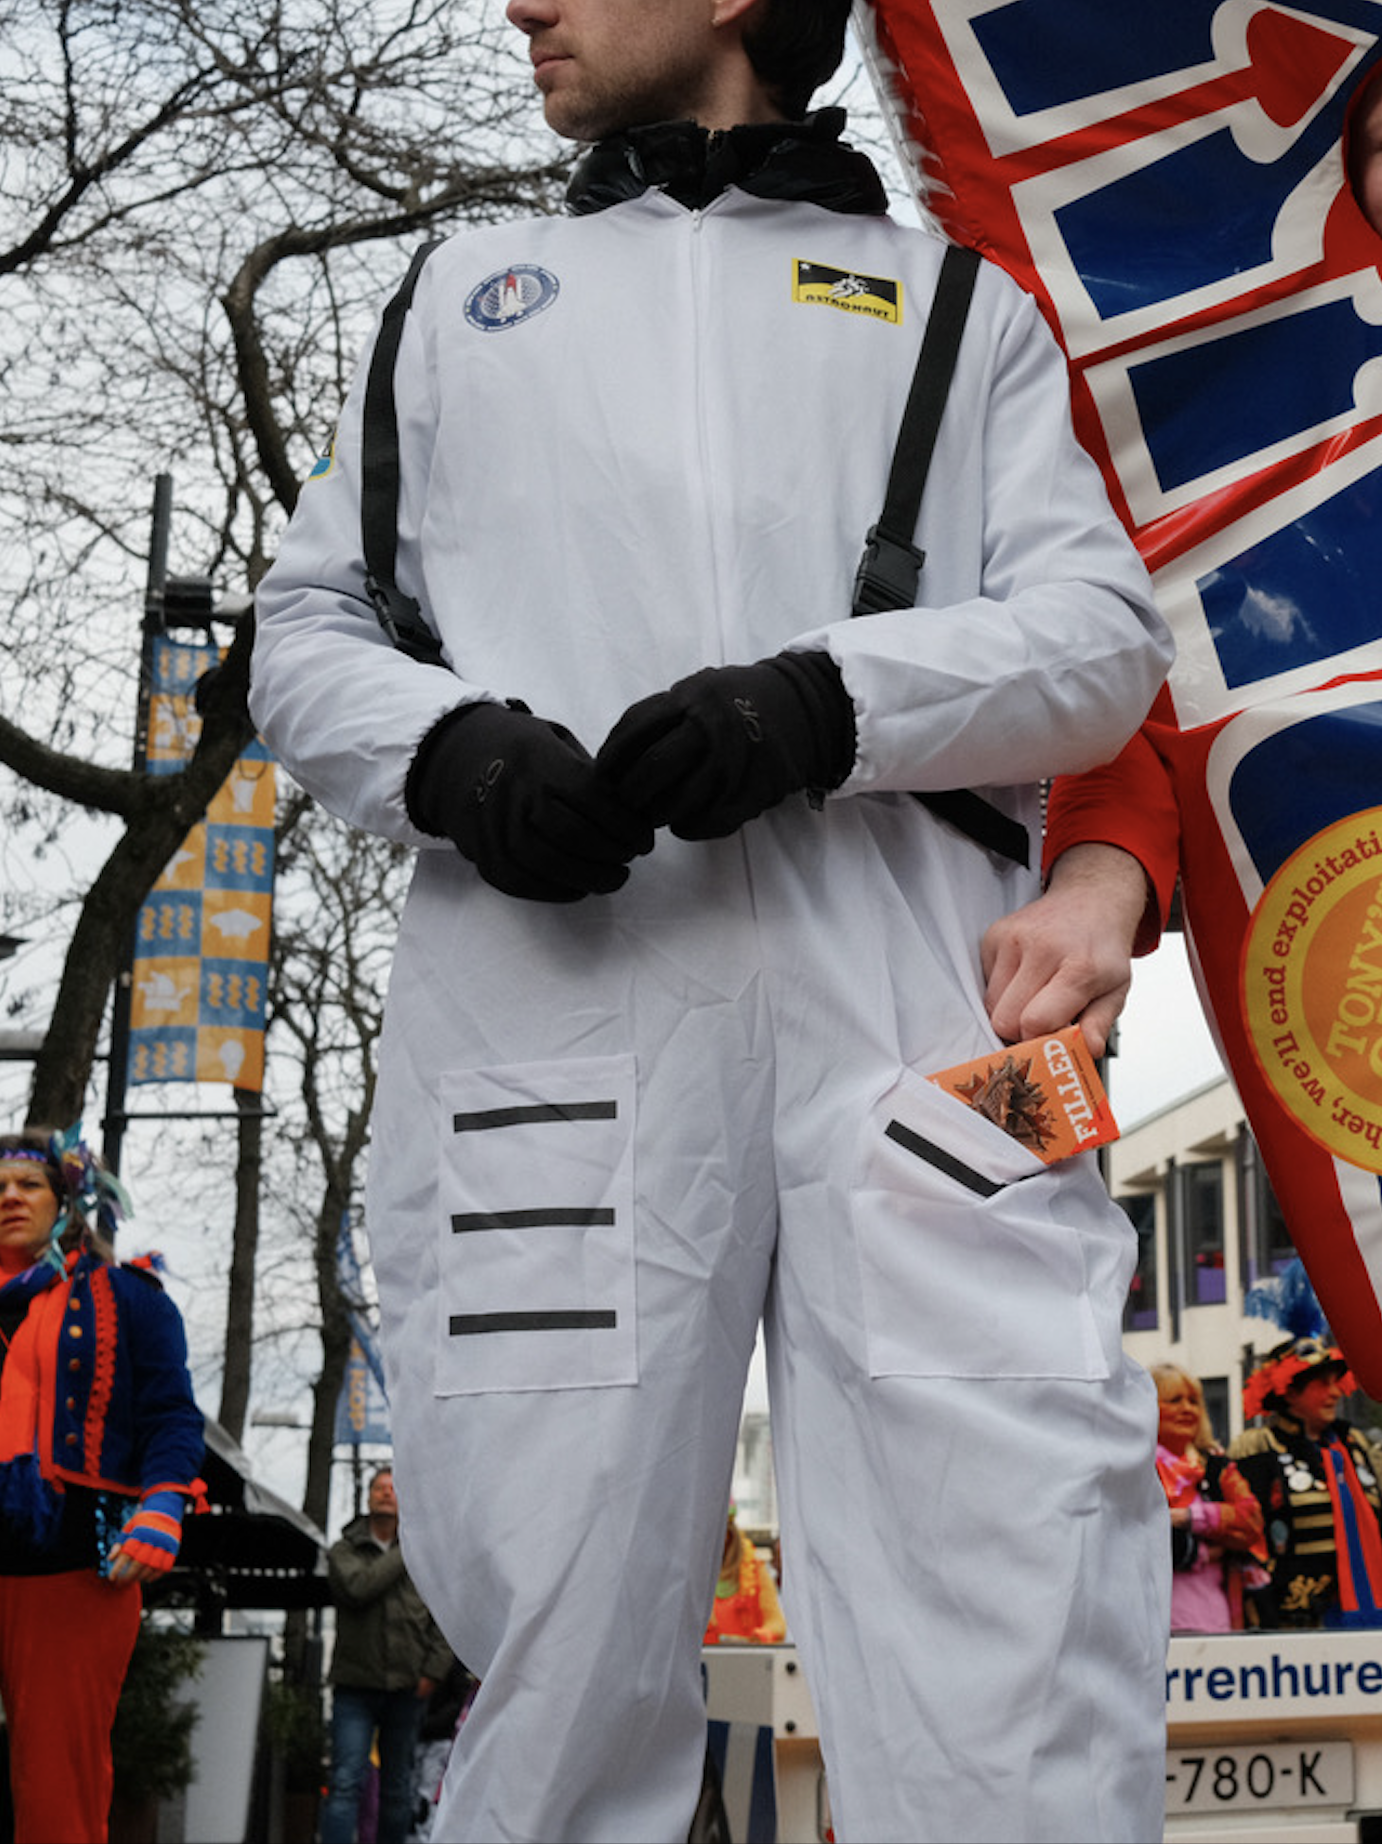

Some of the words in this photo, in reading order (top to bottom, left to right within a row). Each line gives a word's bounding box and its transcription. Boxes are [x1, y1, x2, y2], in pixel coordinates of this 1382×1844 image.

[806, 294, 889, 318] ASTRONAUT
[1263, 965, 1289, 1026] end
[1043, 1038, 1098, 1144] FILLED
[1273, 1030, 1326, 1107] we'll
